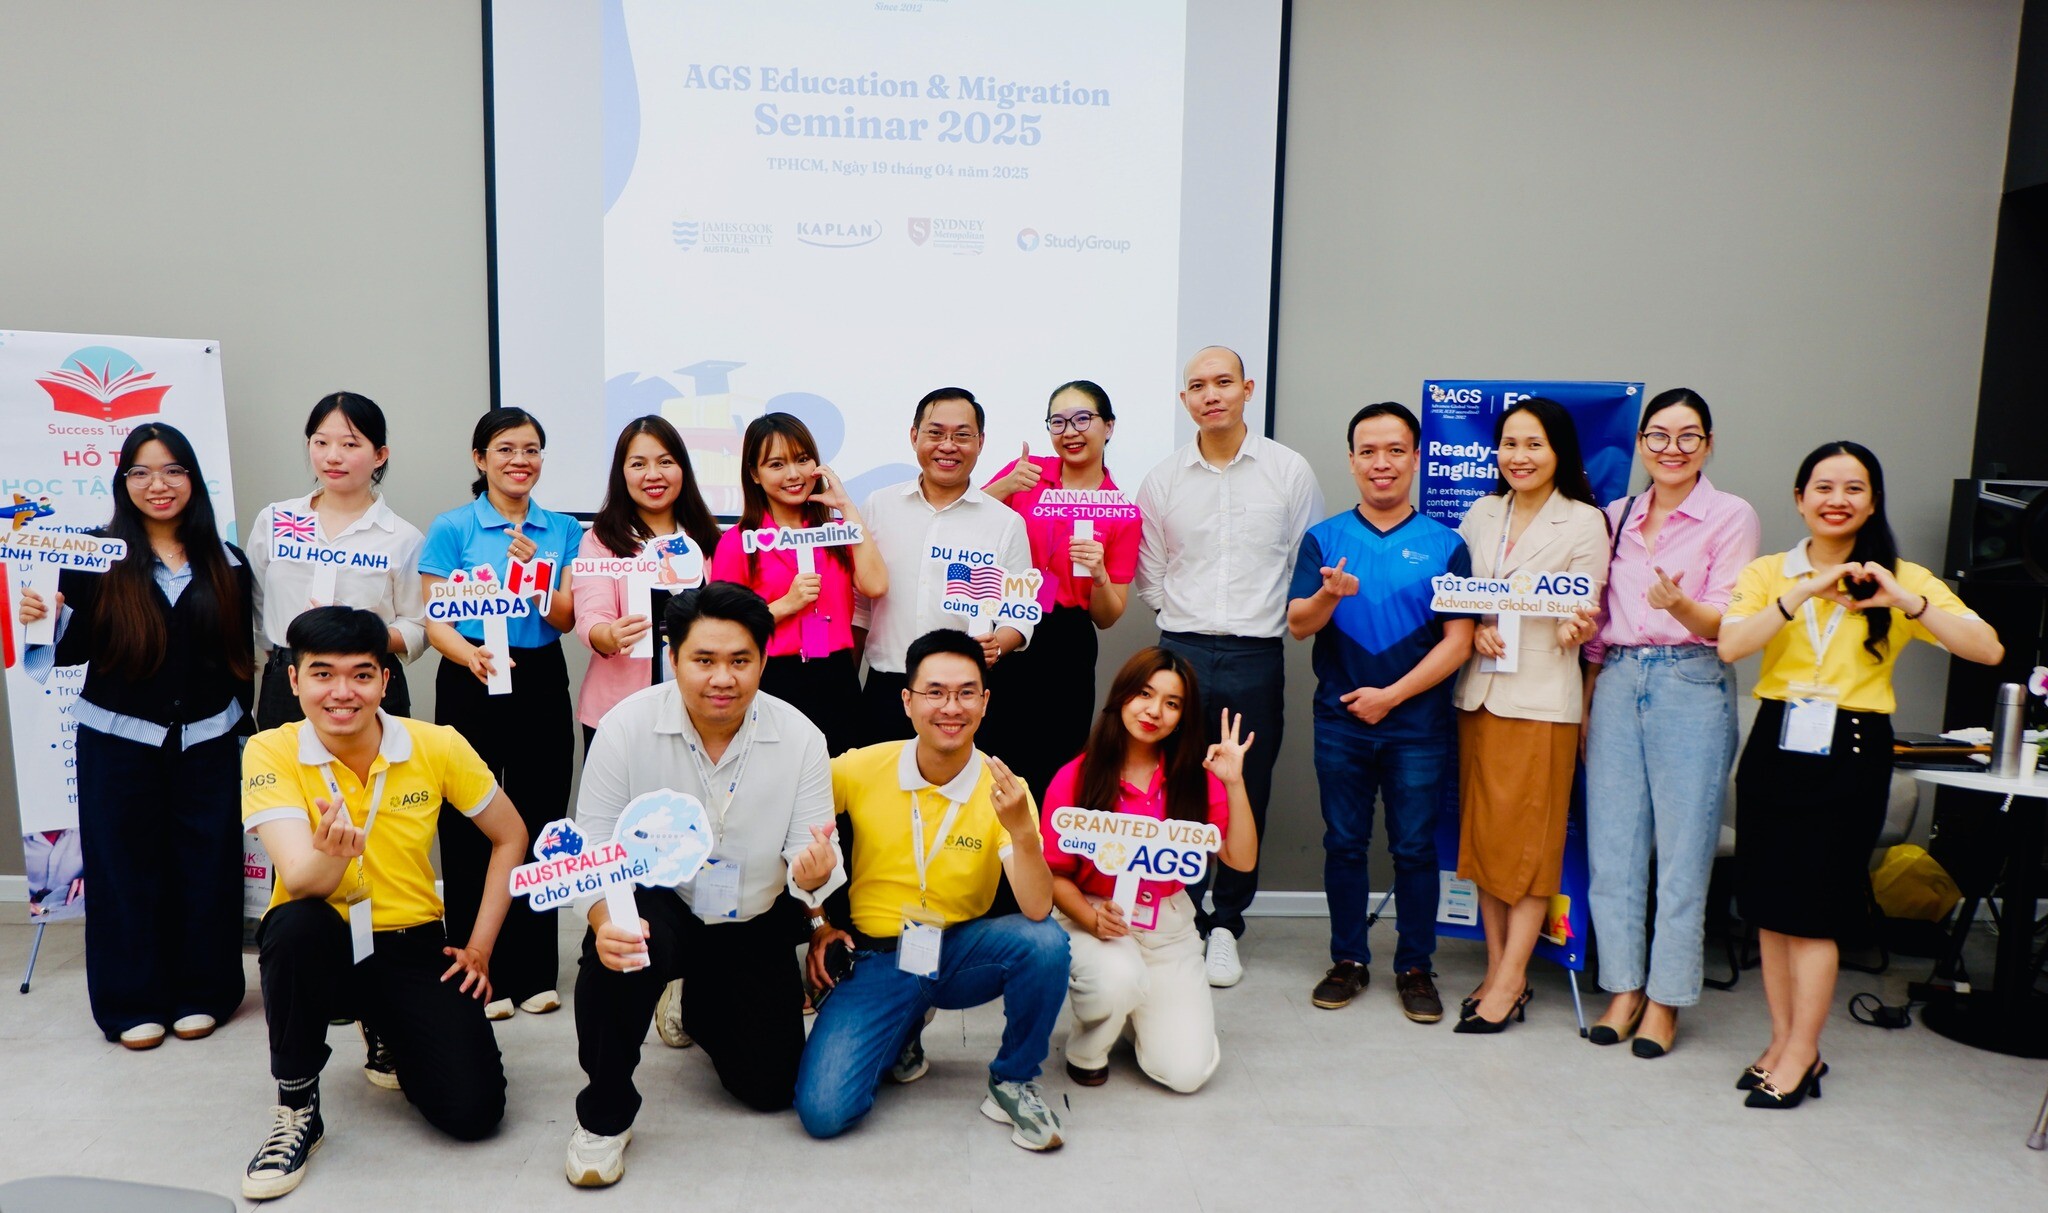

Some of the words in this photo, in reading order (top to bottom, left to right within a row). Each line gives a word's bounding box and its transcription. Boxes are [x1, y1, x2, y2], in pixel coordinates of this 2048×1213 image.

[874, 2, 899, 12] Since
[900, 3, 923, 13] 2012
[683, 63, 752, 91] AGS
[759, 66, 919, 98] Education
[926, 74, 950, 99] &
[956, 75, 1111, 110] Migration
[754, 103, 929, 141] Seminar
[938, 110, 1042, 147] 2025
[766, 157, 829, 174] TPHCM,
[832, 159, 868, 177] Ngày
[873, 161, 888, 174] 19
[891, 161, 933, 179] tháng
[935, 163, 954, 177] 04
[958, 163, 989, 178] năm
[992, 166, 1029, 180] 2025
[702, 222, 738, 233] JAMES
[739, 223, 773, 234] COOK
[797, 222, 873, 237] KAPLAN
[933, 218, 985, 231] SYDNEY
[702, 233, 773, 245] UNIVERSITY
[934, 230, 985, 241] Metropolitan
[1044, 233, 1132, 253] StudyGroup
[703, 246, 750, 254] AUSTRALIA
[1444, 388, 1483, 404] AGS
[48, 423, 105, 436] Success
[108, 424, 134, 436] Tut
[63, 443, 103, 467] HỖ
[1427, 461, 1500, 481] English
[71, 475, 115, 500] TẬ
[1426, 487, 1438, 495] An
[1439, 487, 1486, 497] extensive
[1043, 491, 1126, 504] ANNALINK
[1426, 499, 1460, 507] content
[1032, 506, 1137, 519] OSHC-STUDENTS
[1426, 510, 1445, 518] from
[17, 533, 99, 553] ZEALAND
[779, 525, 859, 546] Annalink
[38, 549, 69, 565] TỚI
[74, 552, 107, 569] ĐÂY!
[277, 544, 302, 560] DU
[306, 547, 347, 567] HỌC
[350, 552, 389, 569] ANH
[930, 546, 953, 560] DU
[958, 549, 994, 567] HỌC
[574, 561, 595, 573] DU
[599, 561, 633, 576] HỌC
[637, 557, 657, 573] ÚC
[435, 586, 456, 598] DU
[462, 583, 498, 599] HỌC
[1004, 572, 1040, 598] MỸ
[1435, 577, 1462, 592] TÔI
[1466, 580, 1511, 596] CHỌN
[1534, 575, 1590, 596] AGS
[429, 597, 526, 619] CANADA
[943, 598, 979, 618] cùng
[998, 602, 1039, 621] AGS
[1434, 596, 1494, 609] Advance
[1497, 598, 1542, 612] Global
[55, 668, 83, 680] học
[249, 773, 277, 789] AGS
[402, 790, 429, 806] AGS
[1056, 812, 1160, 839] GRANTED
[1167, 825, 1217, 846] VISA
[955, 835, 983, 850] AGS
[514, 842, 628, 890] AUSTRALIA
[1062, 837, 1096, 854] cùng
[1127, 845, 1203, 878] AGS
[534, 882, 572, 906] chờ
[576, 872, 603, 893] tôi
[608, 858, 650, 883] nhé!
